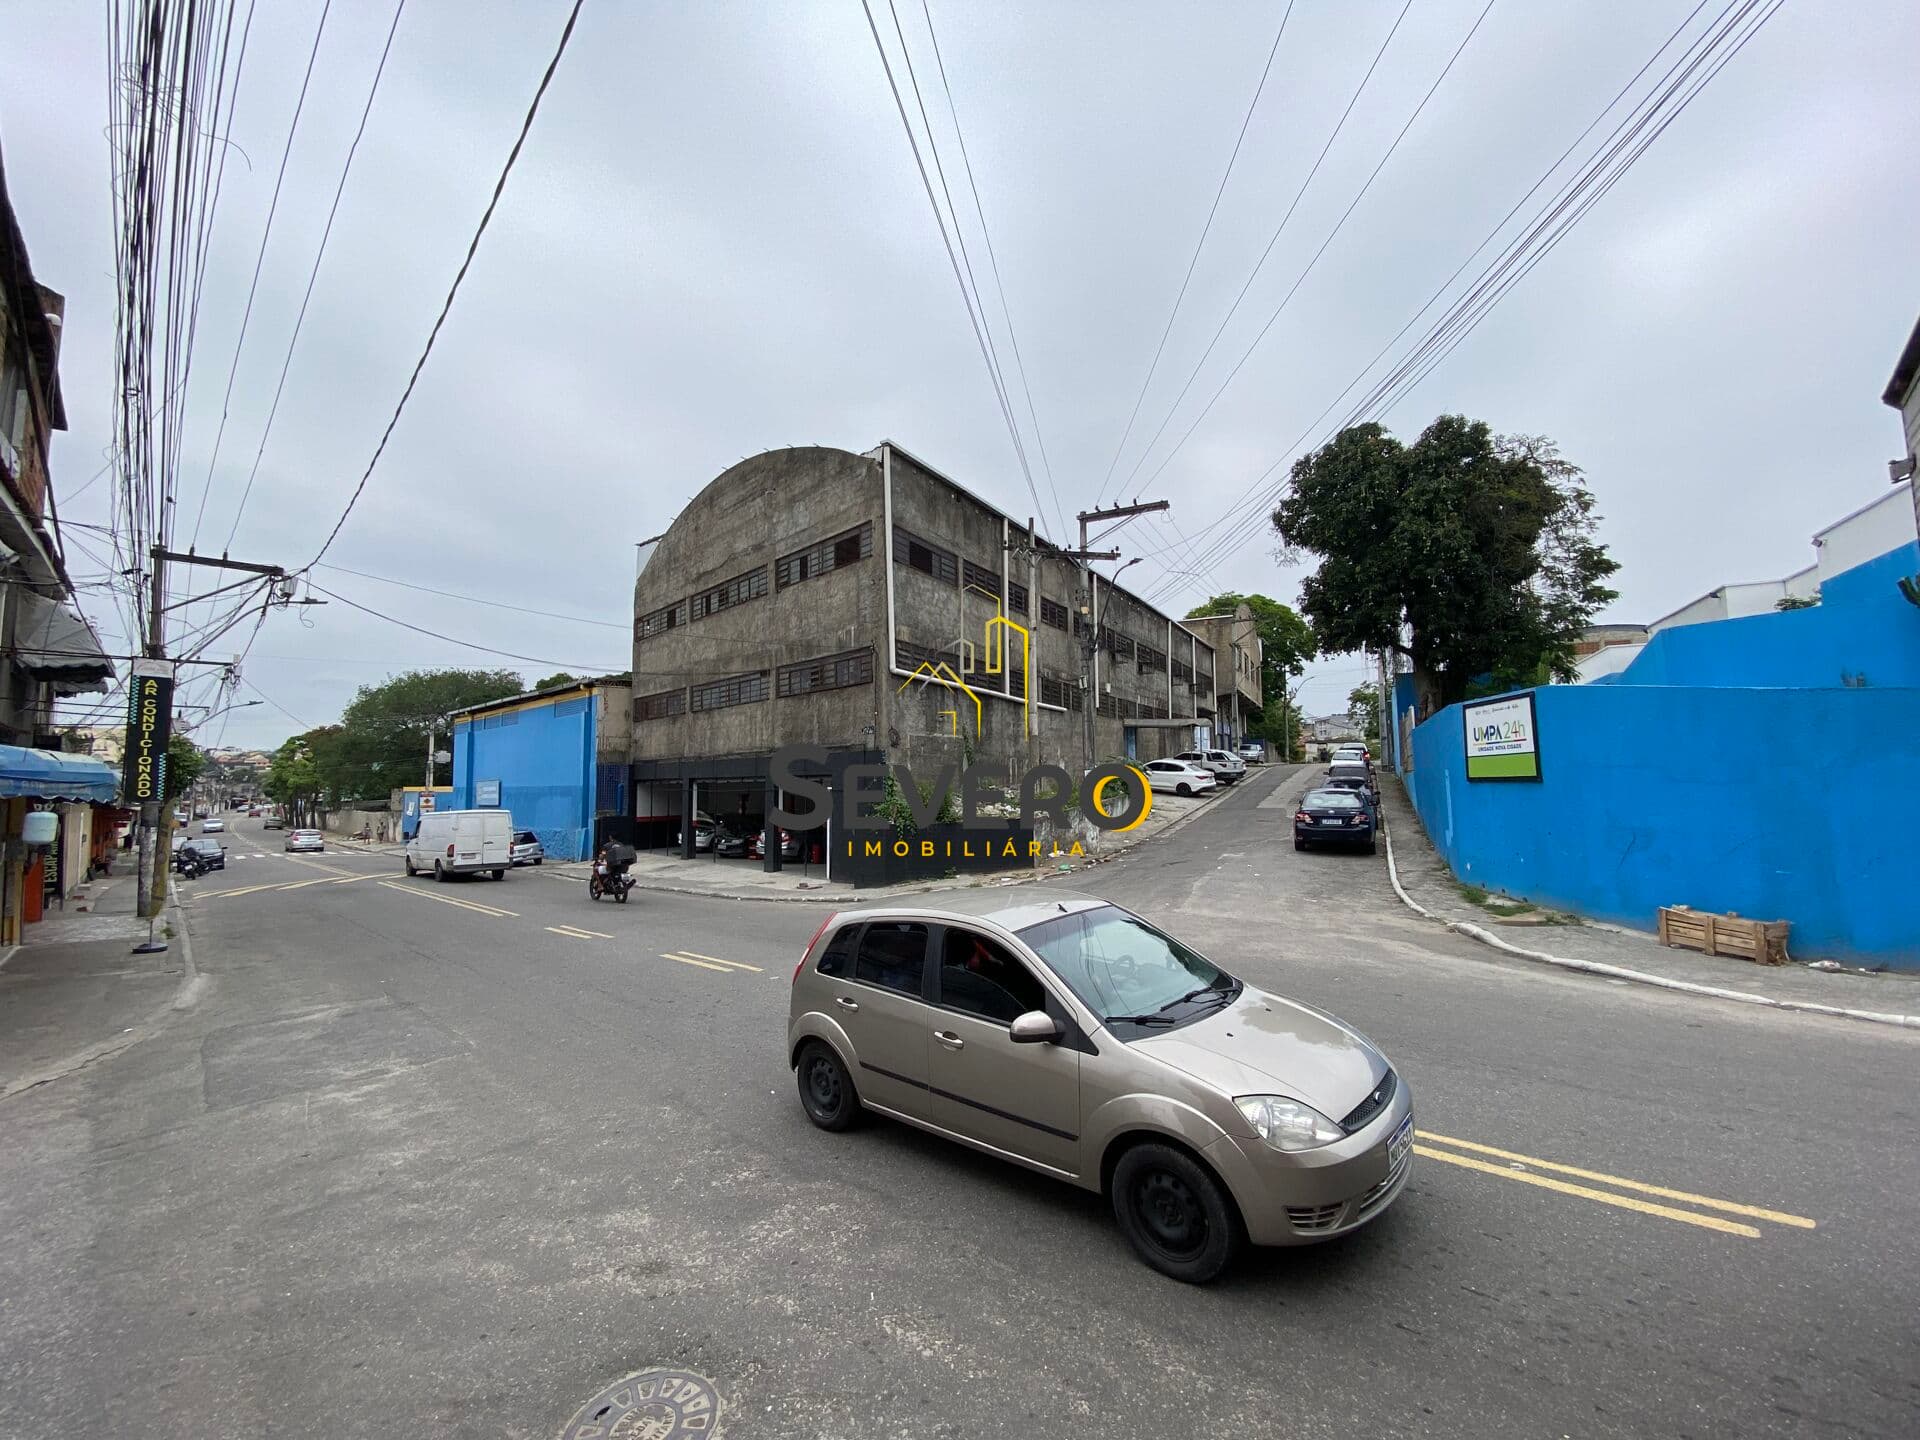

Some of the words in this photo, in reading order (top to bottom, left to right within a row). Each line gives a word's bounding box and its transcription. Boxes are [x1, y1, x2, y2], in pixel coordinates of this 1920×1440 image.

[144, 679, 158, 696] AR
[1473, 724, 1503, 742] UMPA
[1503, 719, 1526, 740] 24h
[137, 698, 157, 797] CONDICIONADO
